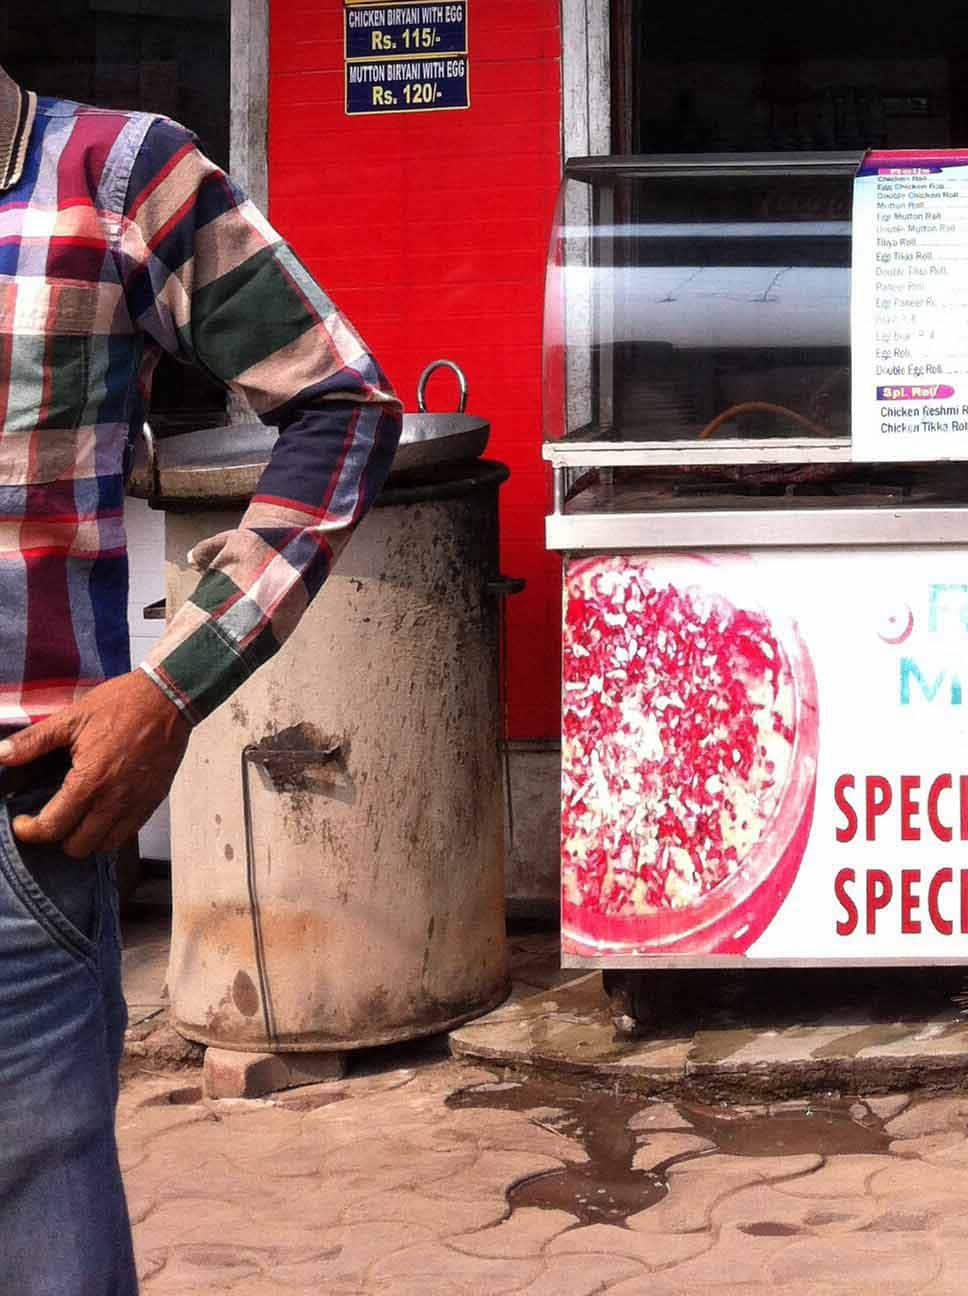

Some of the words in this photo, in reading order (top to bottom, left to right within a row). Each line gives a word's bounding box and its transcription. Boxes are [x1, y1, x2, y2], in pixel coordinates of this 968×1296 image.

[349, 10, 385, 27] CHICKEN
[387, 7, 420, 25] BIRYANI
[422, 7, 442, 24] WITH
[445, 5, 462, 22] EGG
[372, 30, 396, 50] Rs.
[402, 27, 440, 49] 115/-
[350, 64, 385, 83] MUTTON
[387, 62, 421, 81] BIRYANI
[423, 61, 445, 79] WITH
[447, 60, 464, 78] EGG
[373, 86, 397, 105] Rs.
[403, 83, 442, 104] 120/-
[883, 388, 908, 399] Spl.
[881, 406, 920, 418] Chicken
[881, 422, 920, 434] Chicken
[922, 421, 948, 433] Tikka
